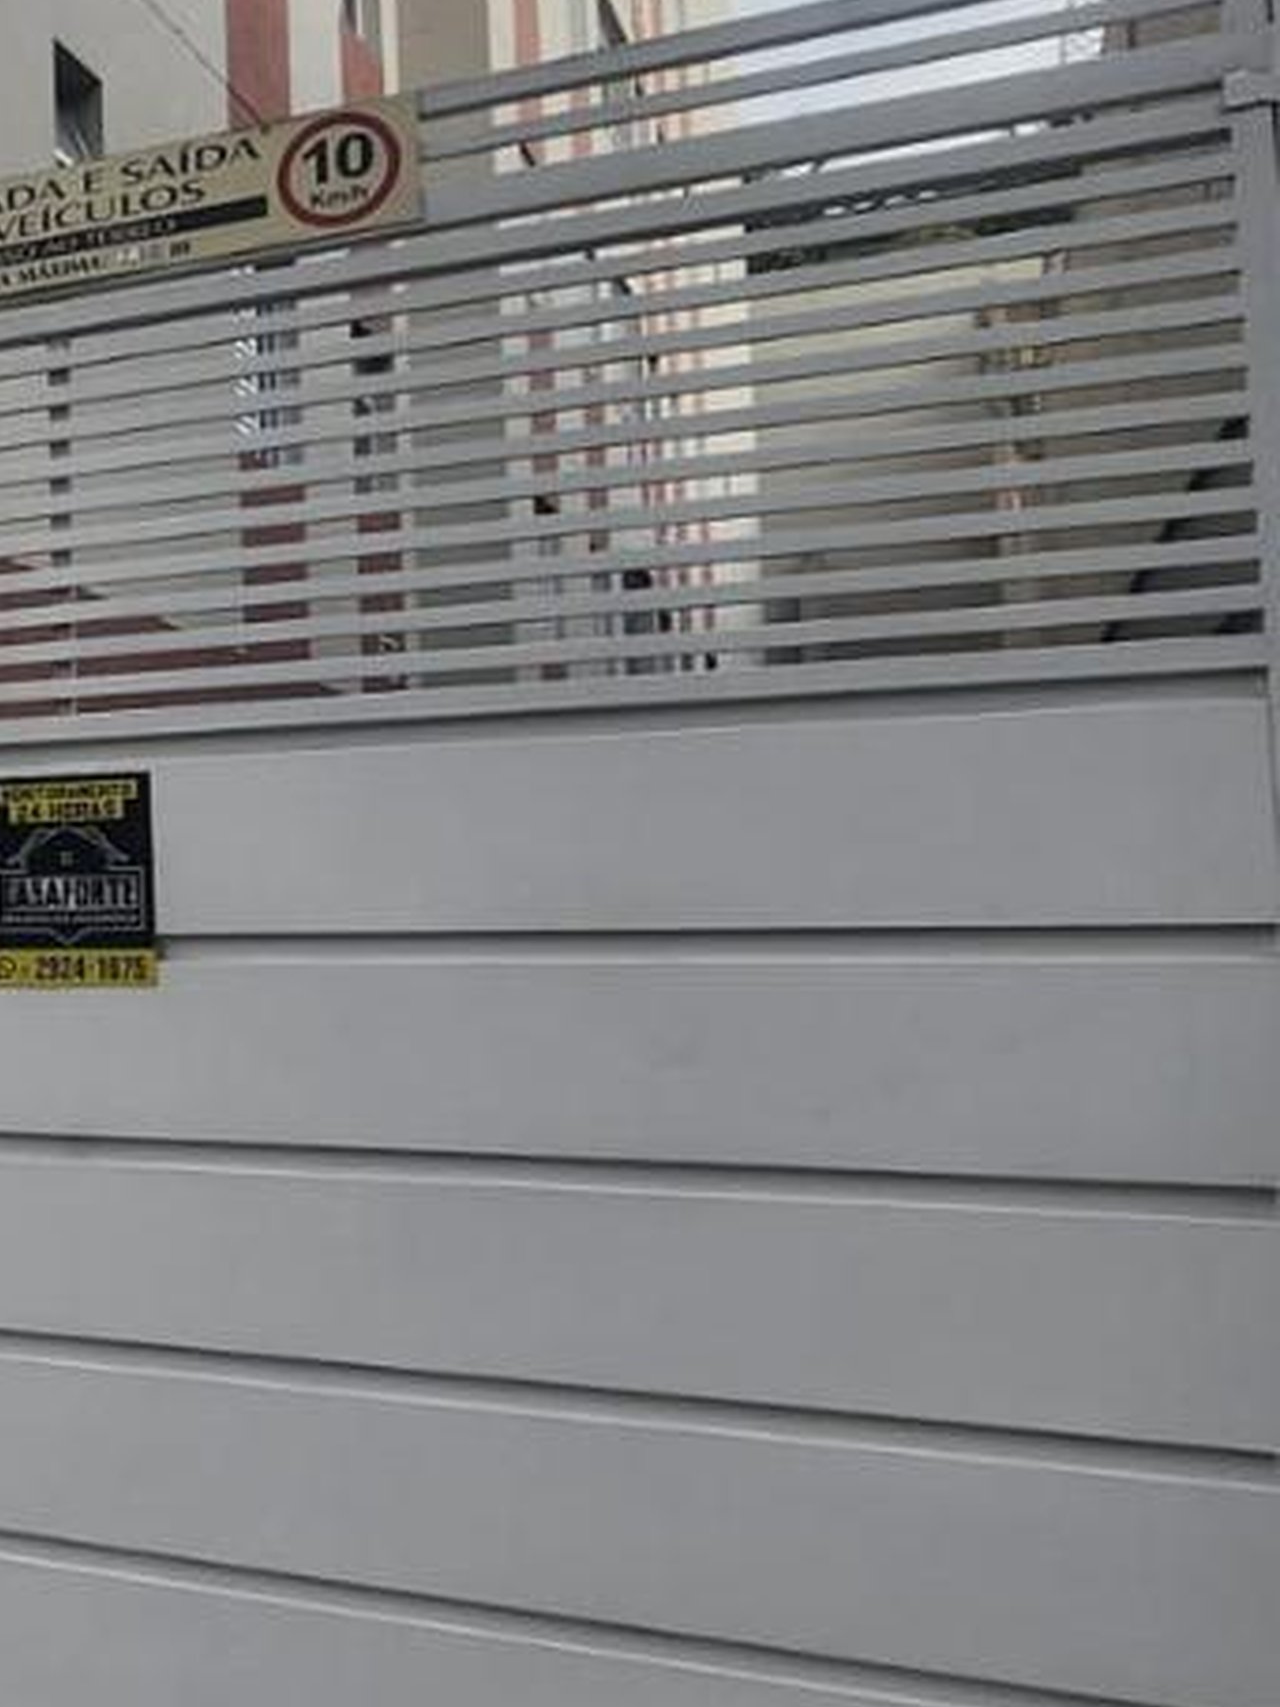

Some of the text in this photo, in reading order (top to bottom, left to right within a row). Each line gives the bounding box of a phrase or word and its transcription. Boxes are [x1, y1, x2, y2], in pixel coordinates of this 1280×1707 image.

[82, 169, 102, 194] E
[120, 137, 261, 186] SAÍDA
[302, 132, 374, 185] 10
